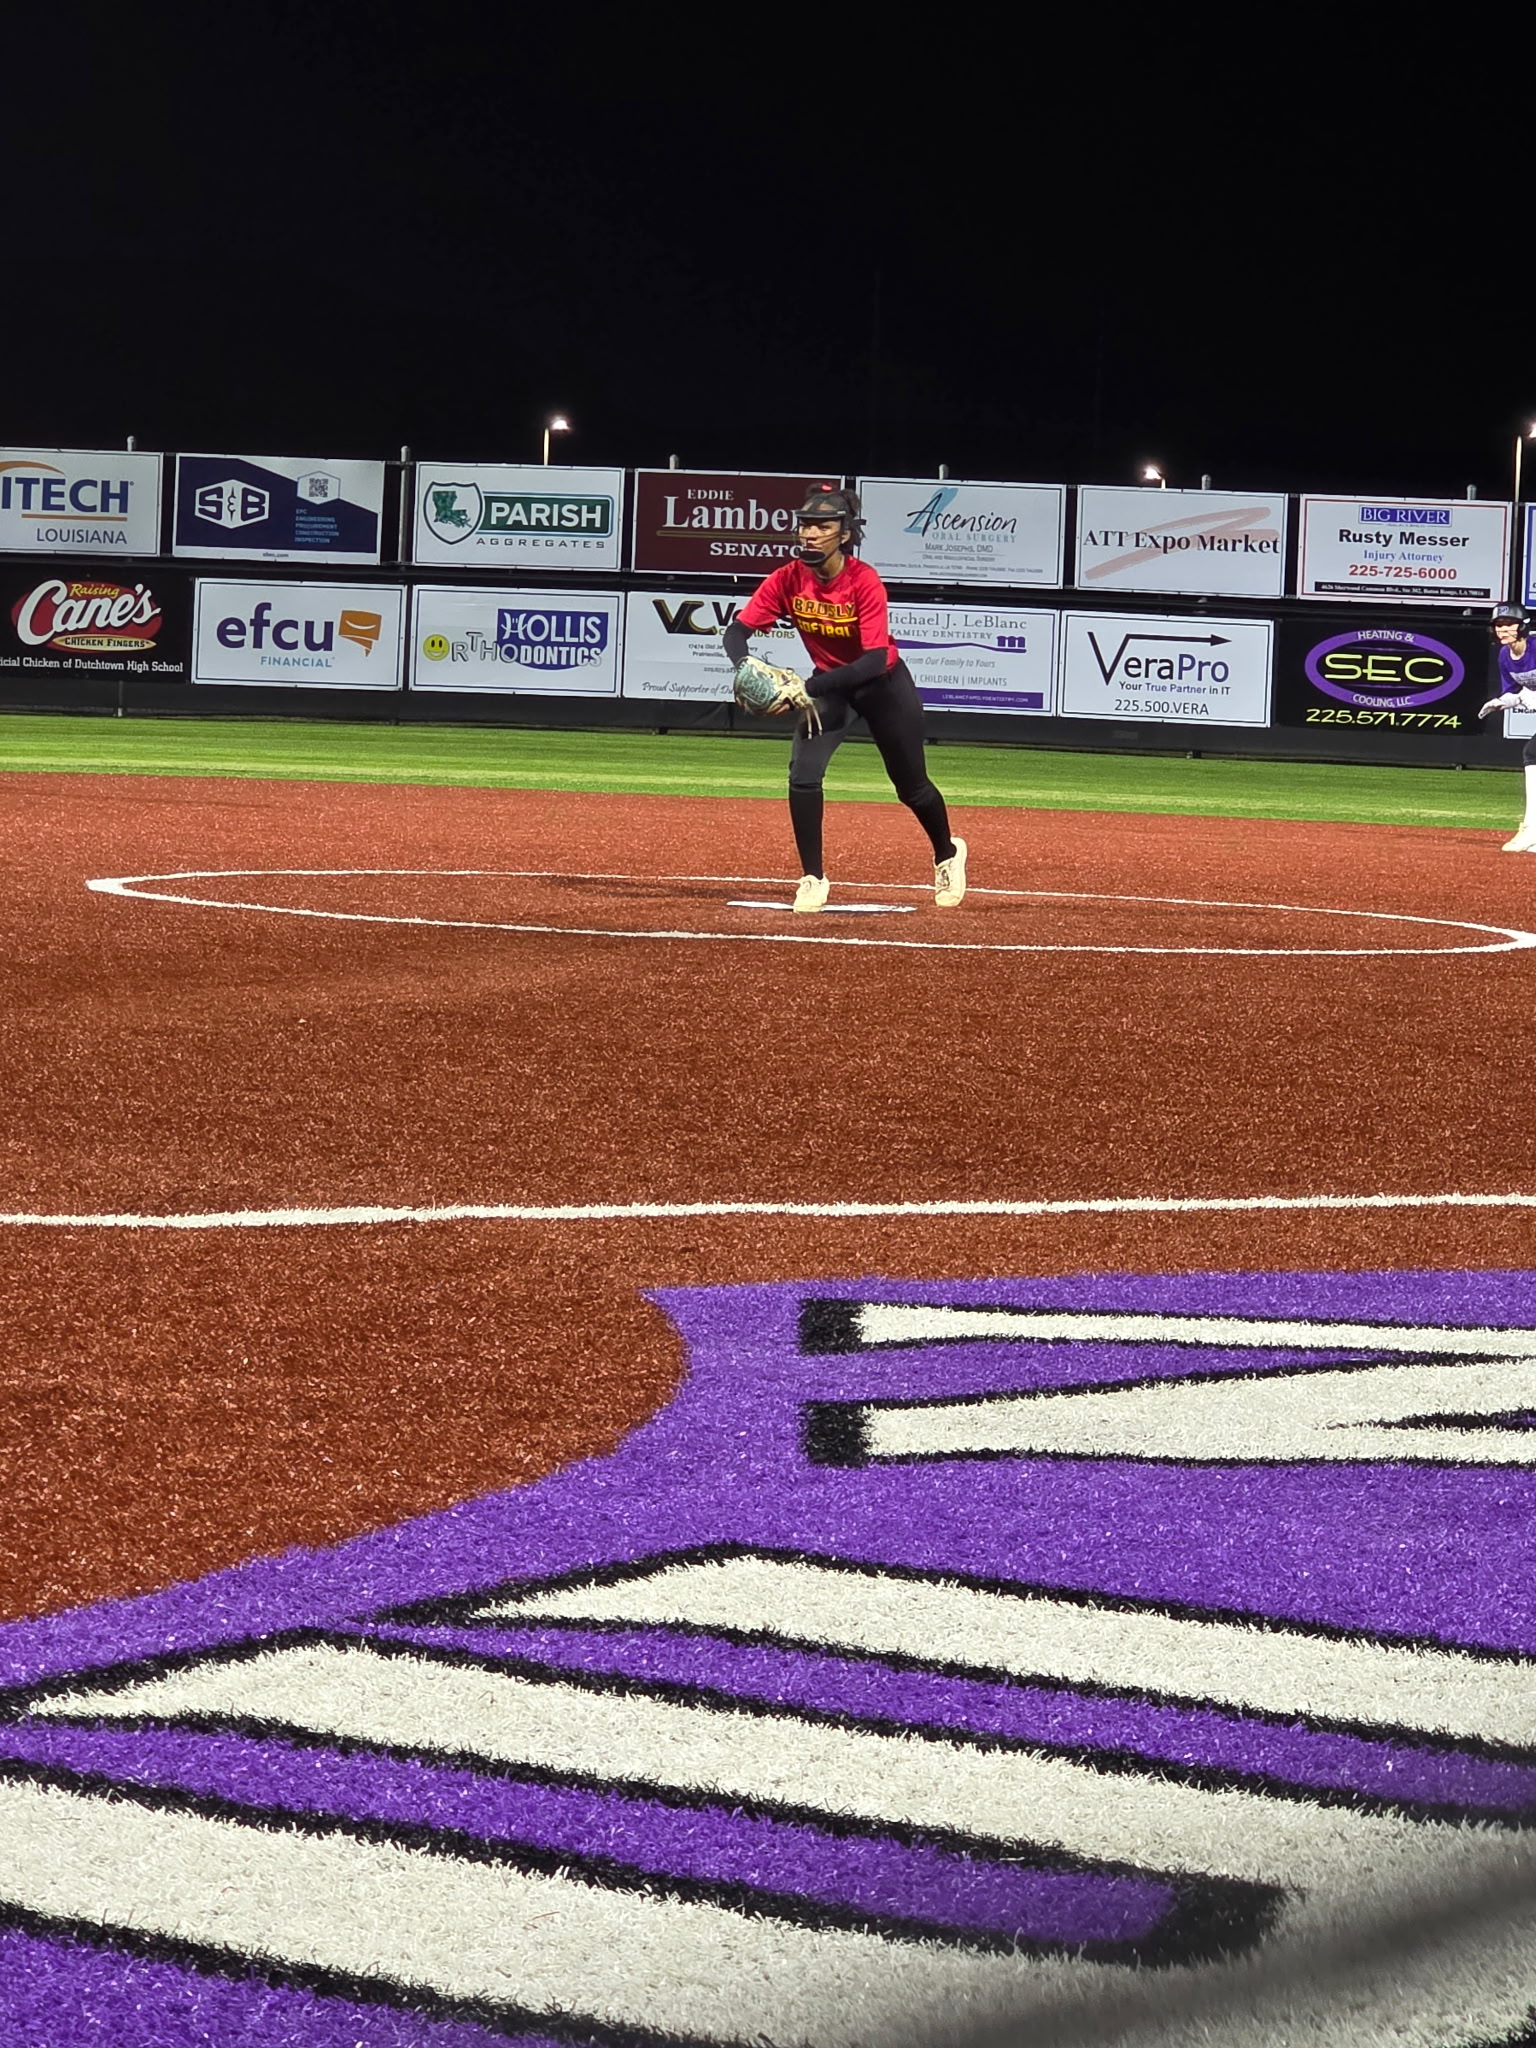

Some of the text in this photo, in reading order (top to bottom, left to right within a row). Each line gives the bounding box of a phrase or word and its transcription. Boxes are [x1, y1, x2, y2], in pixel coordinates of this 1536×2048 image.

[686, 489, 734, 501] EDDIE
[490, 502, 602, 528] PARISH
[662, 495, 799, 532] Lamber
[906, 492, 1018, 537] Ascension
[1362, 507, 1448, 524] BIG RIVER
[36, 528, 127, 544] LOUISIANA
[475, 537, 605, 549] AGGREGATES
[932, 532, 1017, 544] ORAL SURGERY
[1083, 530, 1281, 554] ATT Expo Market
[1338, 529, 1470, 548] Rusty Messer
[709, 542, 803, 558] SENATO
[976, 545, 994, 553] DMD
[1363, 549, 1445, 564] Injury Attorney
[1348, 564, 1458, 580] 225-725-6000
[70, 583, 120, 599] Raising
[17, 579, 161, 645] Cane's
[793, 597, 856, 619] BRUSLY
[216, 602, 334, 652] efcu
[501, 612, 602, 645] HOLLIS
[942, 614, 957, 630] J.
[963, 615, 1027, 630] LeBlanc
[64, 636, 104, 647] CHICKEN
[890, 629, 993, 641] FAMILY DENTISTRY
[1357, 630, 1415, 642] HEATING &
[23, 658, 60, 669] Chicken
[63, 659, 73, 670] of
[74, 659, 125, 671] Dutchtown
[127, 661, 150, 674] High
[152, 662, 184, 673] School
[260, 656, 332, 668] FINANCIAL
[905, 656, 996, 670] From Our Family to Yours
[1087, 632, 1230, 687] VeraPro
[1324, 653, 1445, 683] SEC
[641, 681, 669, 693] Proud
[669, 683, 709, 698] Supporter
[710, 684, 721, 697] of
[919, 675, 1008, 688] CHILDREN IMPLANTS
[1118, 682, 1231, 696] Your True Partner in IT
[1114, 699, 1210, 716] 225.500.VERA
[1352, 693, 1413, 708] COOLING, LLC
[1305, 708, 1462, 729] 225.571.7774
